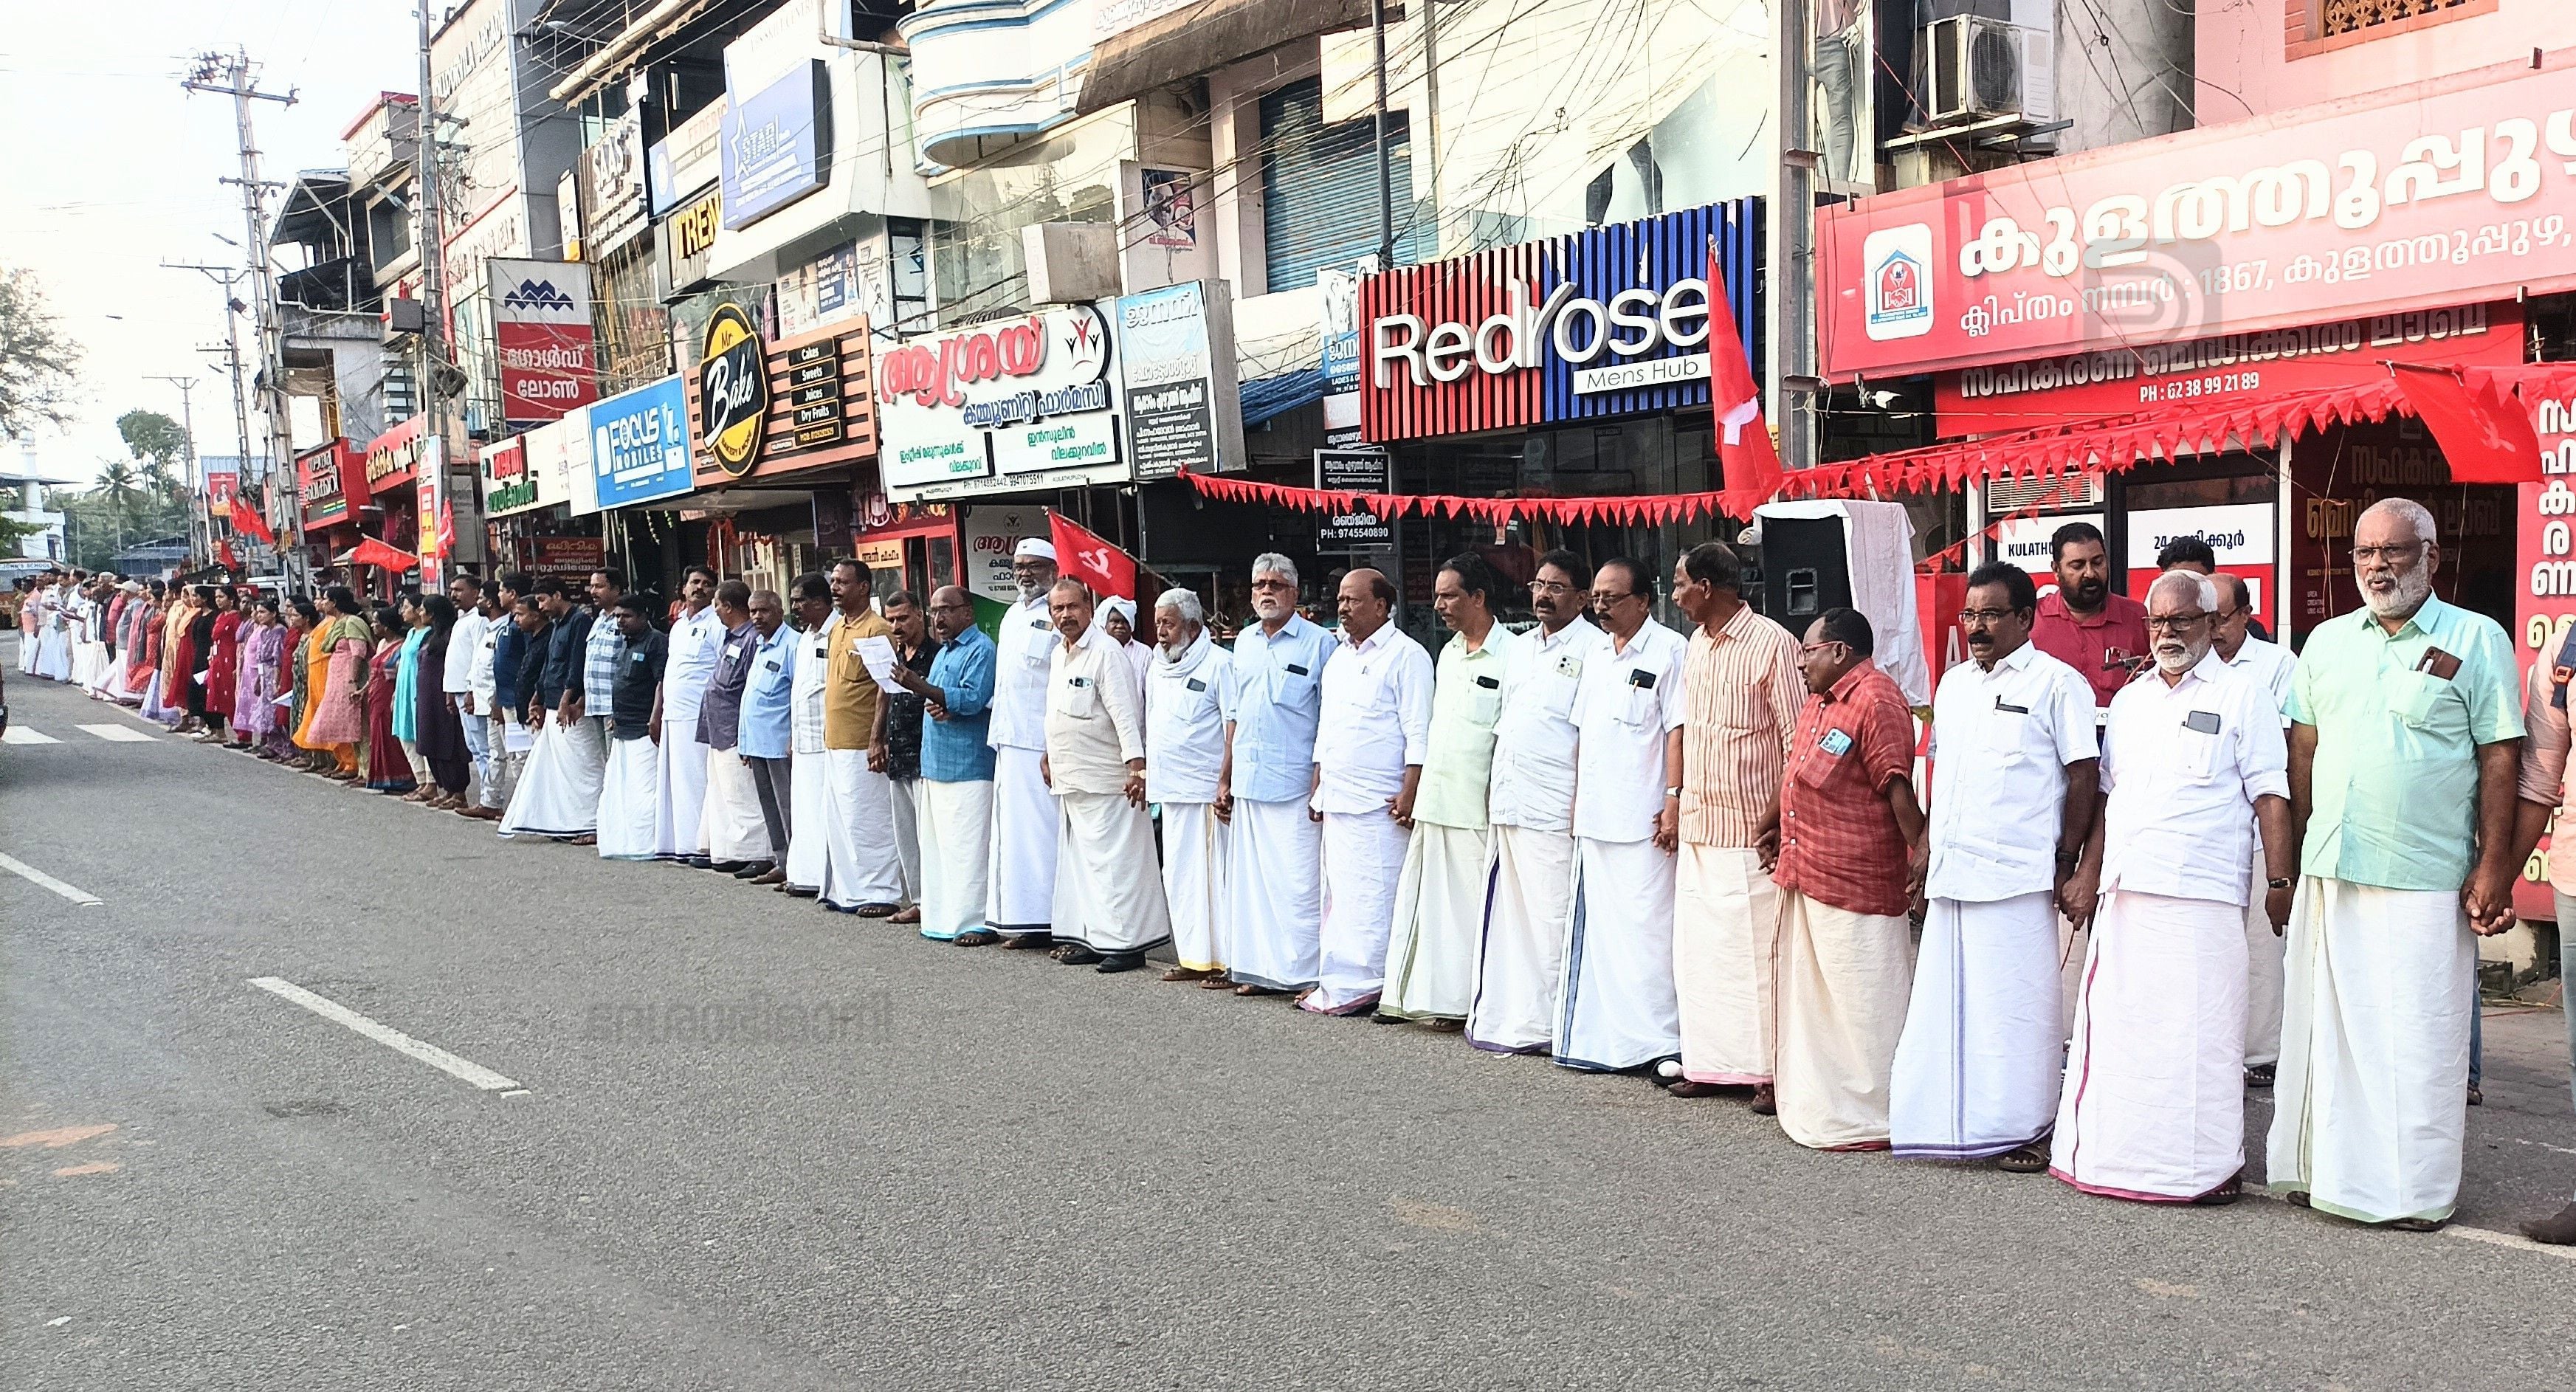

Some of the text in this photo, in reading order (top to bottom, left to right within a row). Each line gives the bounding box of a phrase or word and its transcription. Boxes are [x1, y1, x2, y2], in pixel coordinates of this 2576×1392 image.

[743, 122, 776, 164] STAR
[676, 193, 720, 259] TREN
[2083, 272, 2177, 314] നമ്പർ
[2198, 258, 2273, 297] 1867,
[2284, 213, 2572, 285] കുളത്തൂപ്പുഴ,
[507, 344, 585, 368] ഗോൾഡ്
[801, 347, 819, 360] Cakes
[802, 366, 823, 382] Sweets
[1587, 358, 1699, 390] Mens Hub
[2185, 379, 2201, 396] 38
[2204, 377, 2221, 396] 99
[2225, 375, 2239, 391] 21
[2241, 371, 2259, 390] 89
[517, 377, 579, 399] ലോൺ
[805, 387, 823, 402] Juices
[703, 354, 754, 448] Bake
[963, 380, 1106, 430] കമ്മ്യൂണിറ്റി ഫാർമസി
[801, 405, 830, 422] Dry Fruits
[1027, 426, 1075, 447] ഇൻസുലിൻ
[616, 444, 663, 469] MOBILES
[1051, 441, 1106, 461] വിലക്കുറവിൽ
[1338, 528, 1388, 539] 9745540890
[2154, 536, 2166, 550] 24
